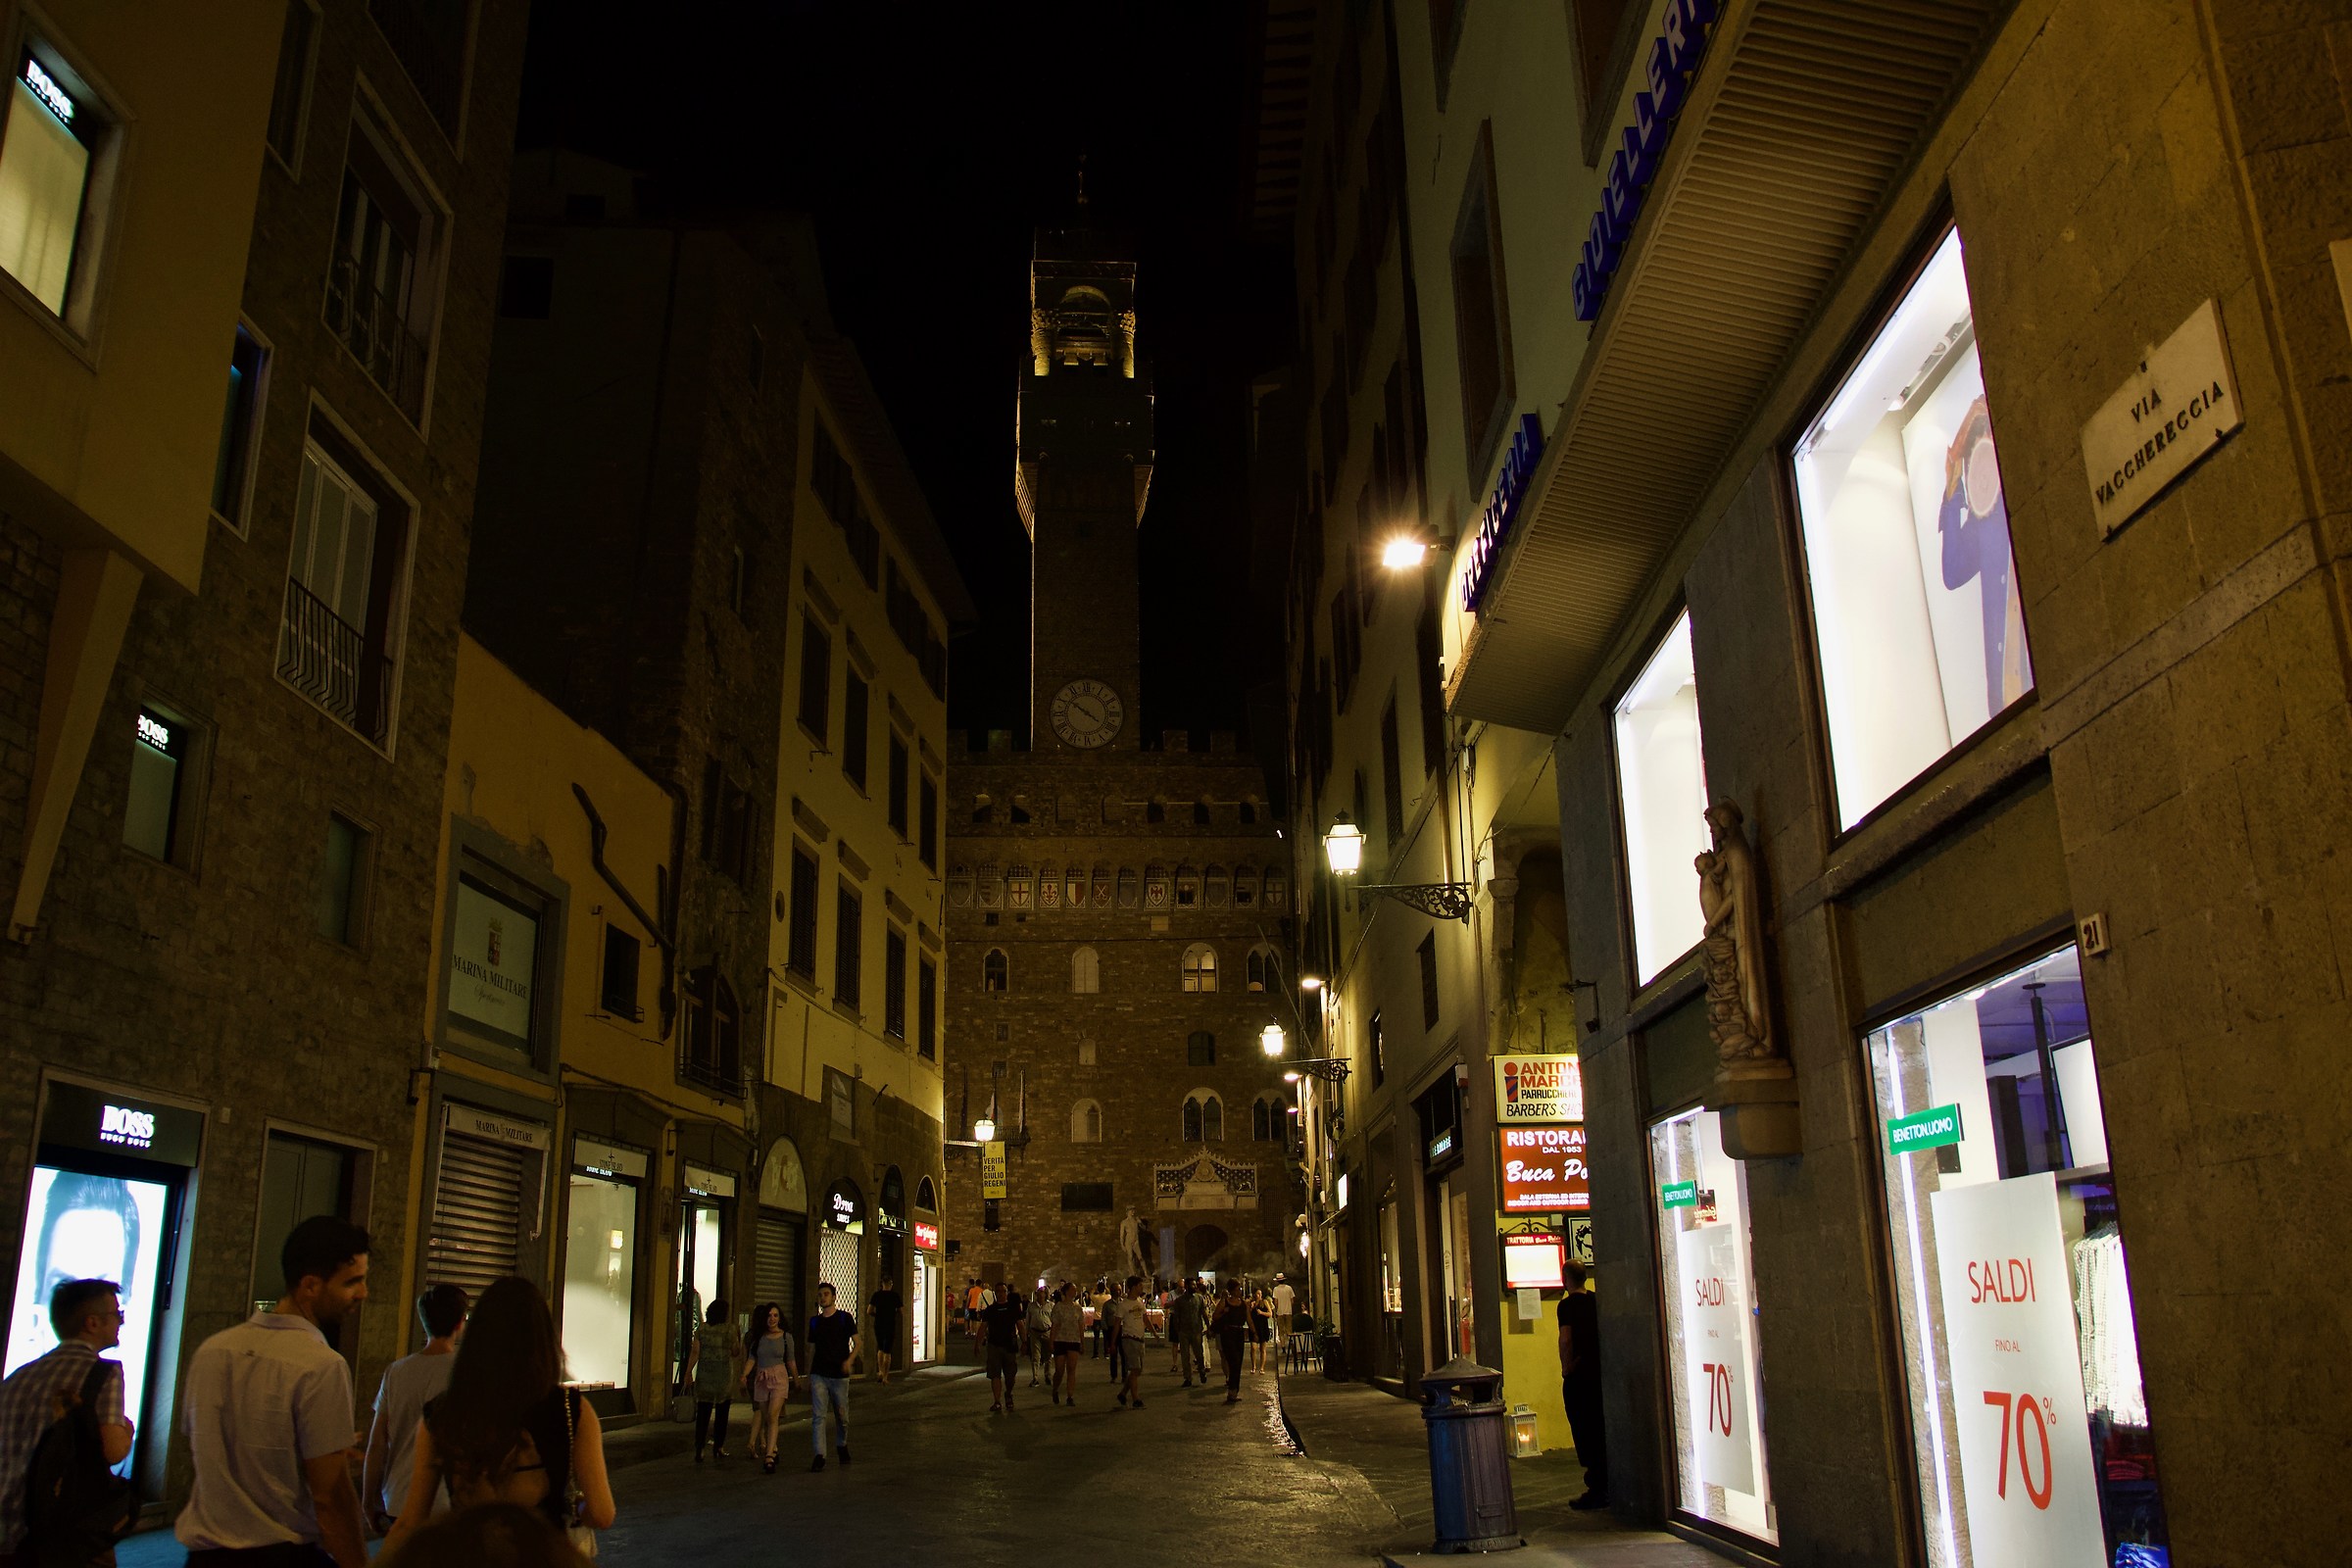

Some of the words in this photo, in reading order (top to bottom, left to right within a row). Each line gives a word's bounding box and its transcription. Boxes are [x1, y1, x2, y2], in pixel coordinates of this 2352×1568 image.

[27, 59, 75, 119] BOSS
[1571, 0, 1710, 320] GIOIELLER
[2131, 388, 2162, 422] VIA
[2095, 381, 2224, 505] VACCHERECCIA
[1461, 414, 1535, 612] OREFICERIA
[2083, 920, 2099, 950] 21
[453, 954, 487, 982] MARINA
[490, 970, 528, 1000] MILITARE
[101, 1104, 154, 1138] BOSS
[1506, 1103, 1556, 1117] BARBER'S
[1505, 1159, 1555, 1183] Buca
[1695, 1277, 1725, 1306] SALDI
[1968, 1257, 2035, 1303] SALDI
[1994, 1340, 2010, 1352] FINO
[2012, 1342, 2021, 1352] AL
[1983, 1391, 2056, 1510] 70%
